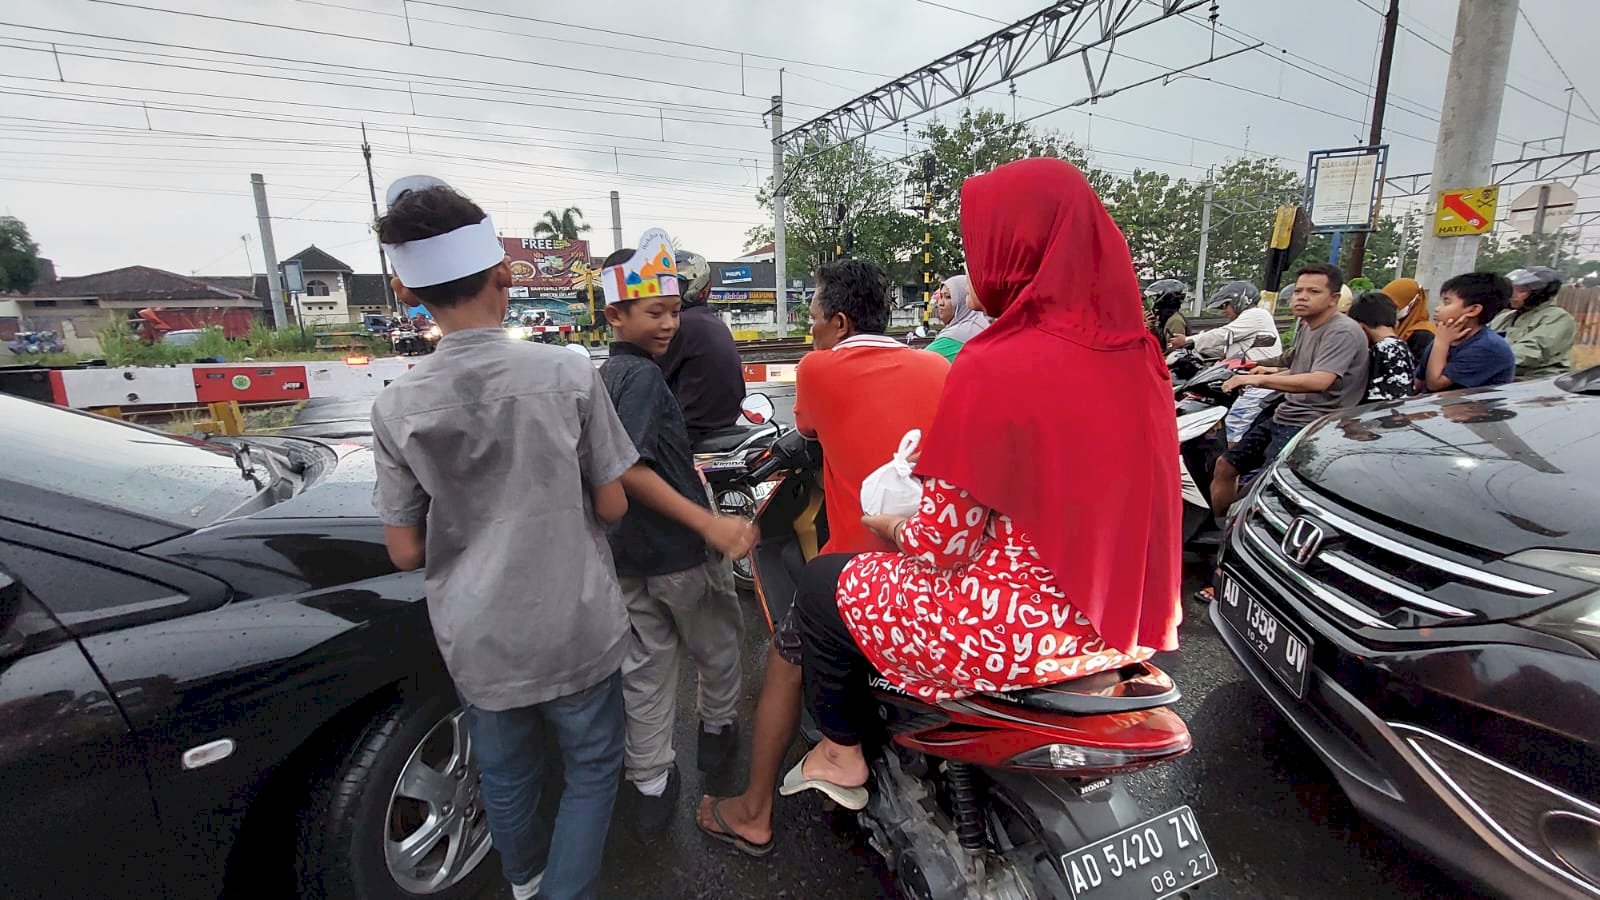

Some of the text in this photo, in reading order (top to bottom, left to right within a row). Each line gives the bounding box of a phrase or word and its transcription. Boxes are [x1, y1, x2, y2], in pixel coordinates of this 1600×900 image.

[521, 239, 553, 250] FREE
[1223, 577, 1240, 608] AD
[1246, 596, 1278, 645] 1358
[1079, 778, 1111, 795] HONDA
[1070, 811, 1199, 894] AD 5420 ZV
